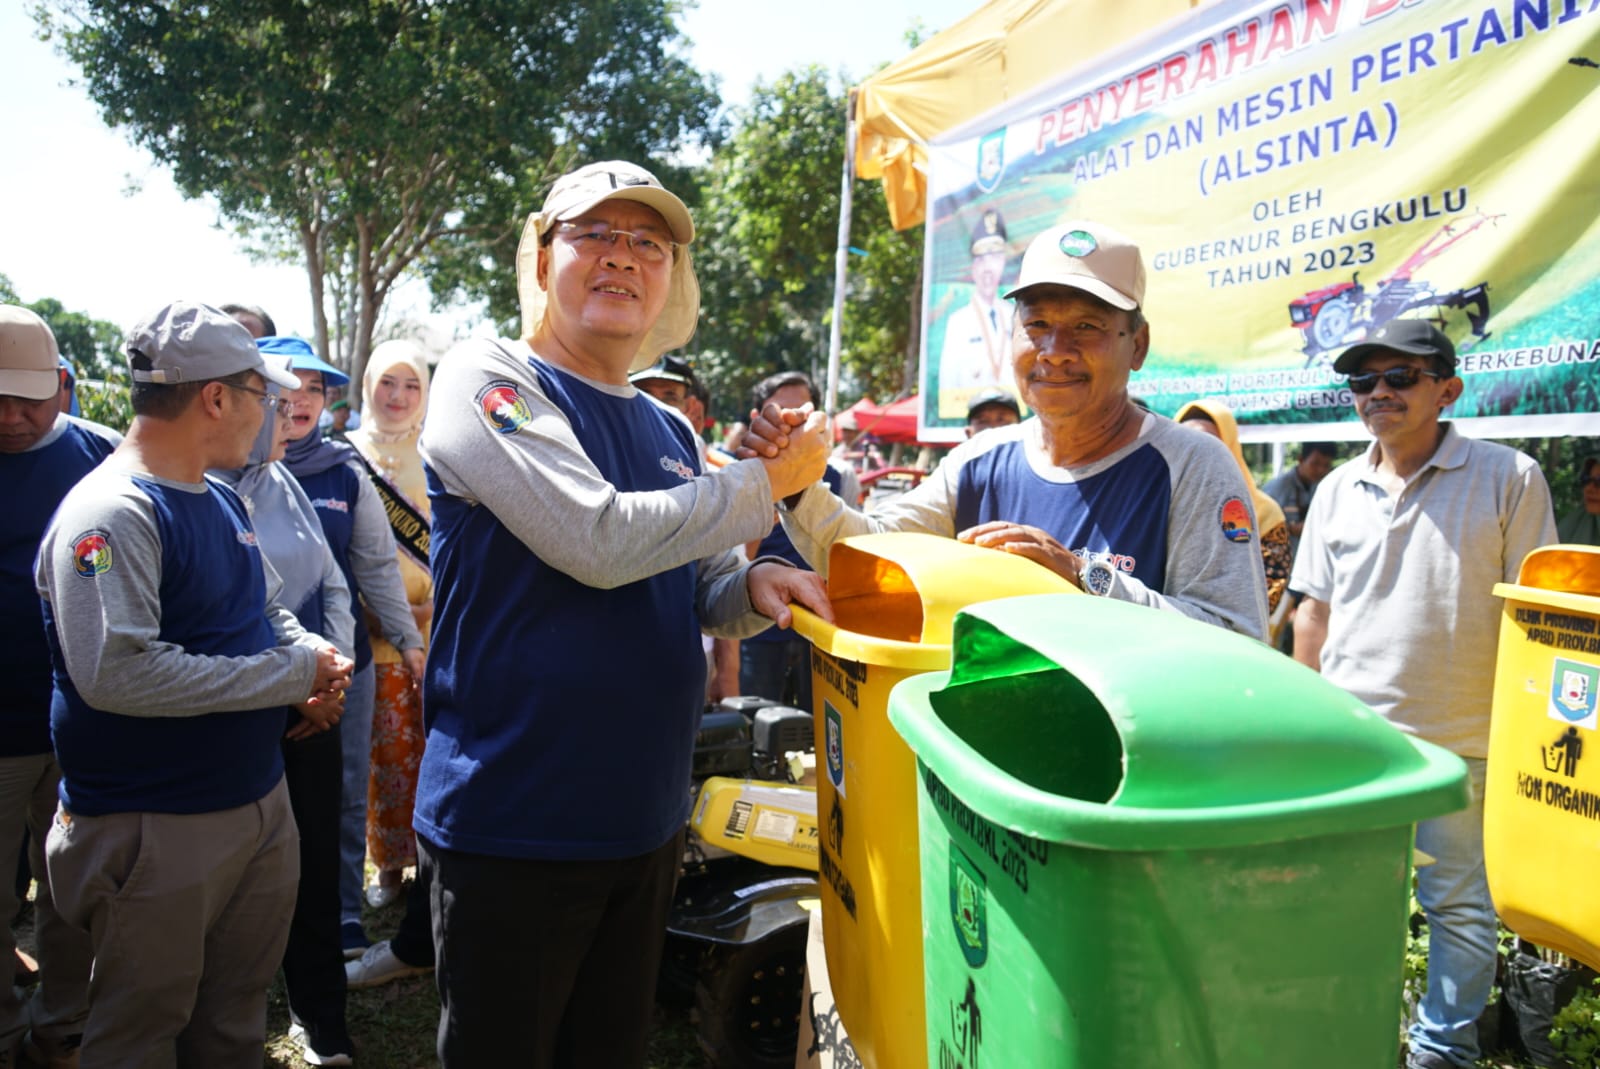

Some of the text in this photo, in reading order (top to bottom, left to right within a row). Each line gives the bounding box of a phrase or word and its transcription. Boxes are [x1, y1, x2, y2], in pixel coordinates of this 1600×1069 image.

[1035, 0, 1343, 153] PENYERAHAN
[1074, 0, 1600, 184] ALAT DAN MESIN PERTANI
[1200, 102, 1398, 195] (ALSINTA)
[1153, 187, 1467, 271] GUBERNUR BENGKULU
[1253, 189, 1323, 221] OLEH
[1208, 241, 1376, 288] TAHUN 2023
[1527, 627, 1554, 647] APBD
[1544, 612, 1596, 633] PROVINSI
[1516, 771, 1543, 803] NON
[1001, 839, 1029, 894] 2023
